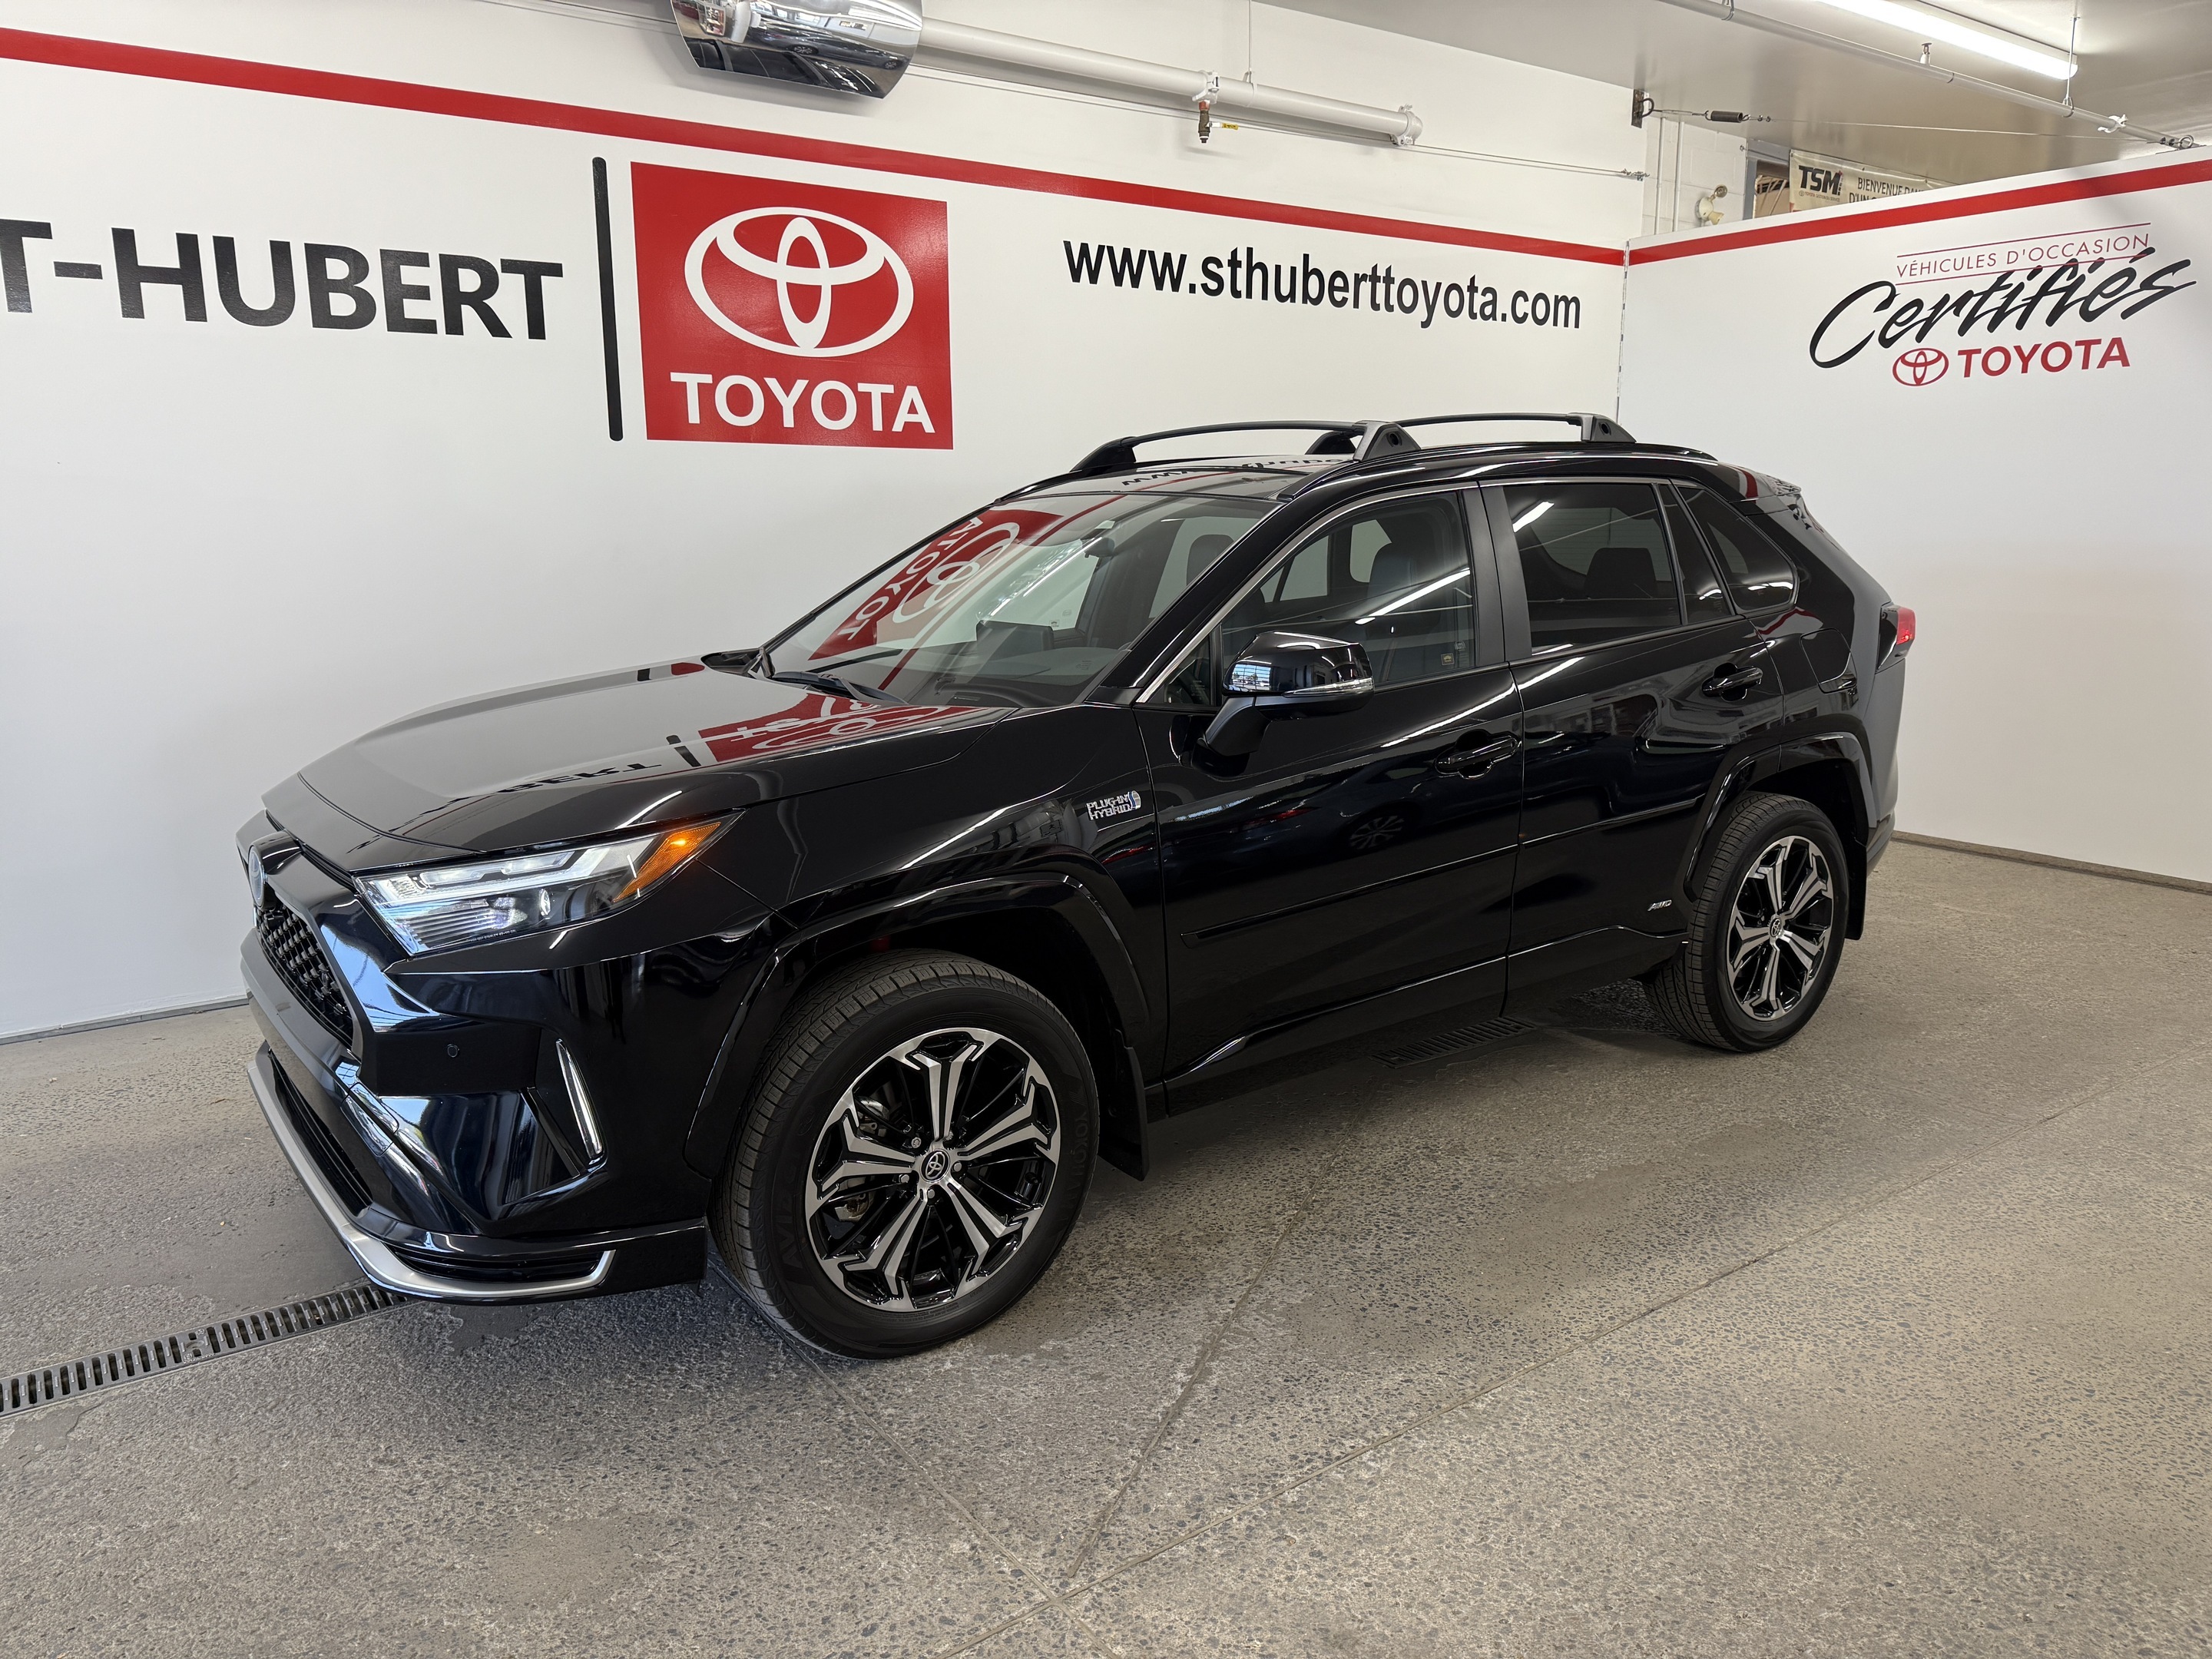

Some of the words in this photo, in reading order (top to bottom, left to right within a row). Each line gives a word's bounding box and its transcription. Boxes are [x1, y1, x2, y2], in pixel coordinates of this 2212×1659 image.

[1798, 165, 1841, 195] TSM
[1857, 177, 1902, 196] BIENVENUE
[1897, 253, 1997, 277] VÉHICULES
[2006, 233, 2148, 265] D'OCCASION
[0, 218, 563, 340] T-HUBERT
[1063, 240, 1581, 329] www.sthuberttoyota.com
[1810, 247, 2197, 369] Certifiés
[1958, 336, 2131, 378] TOYOTA
[670, 372, 935, 433] TOYOTA
[1086, 794, 1128, 810] PLUG-IN
[1088, 803, 1131, 820] HYBRID
